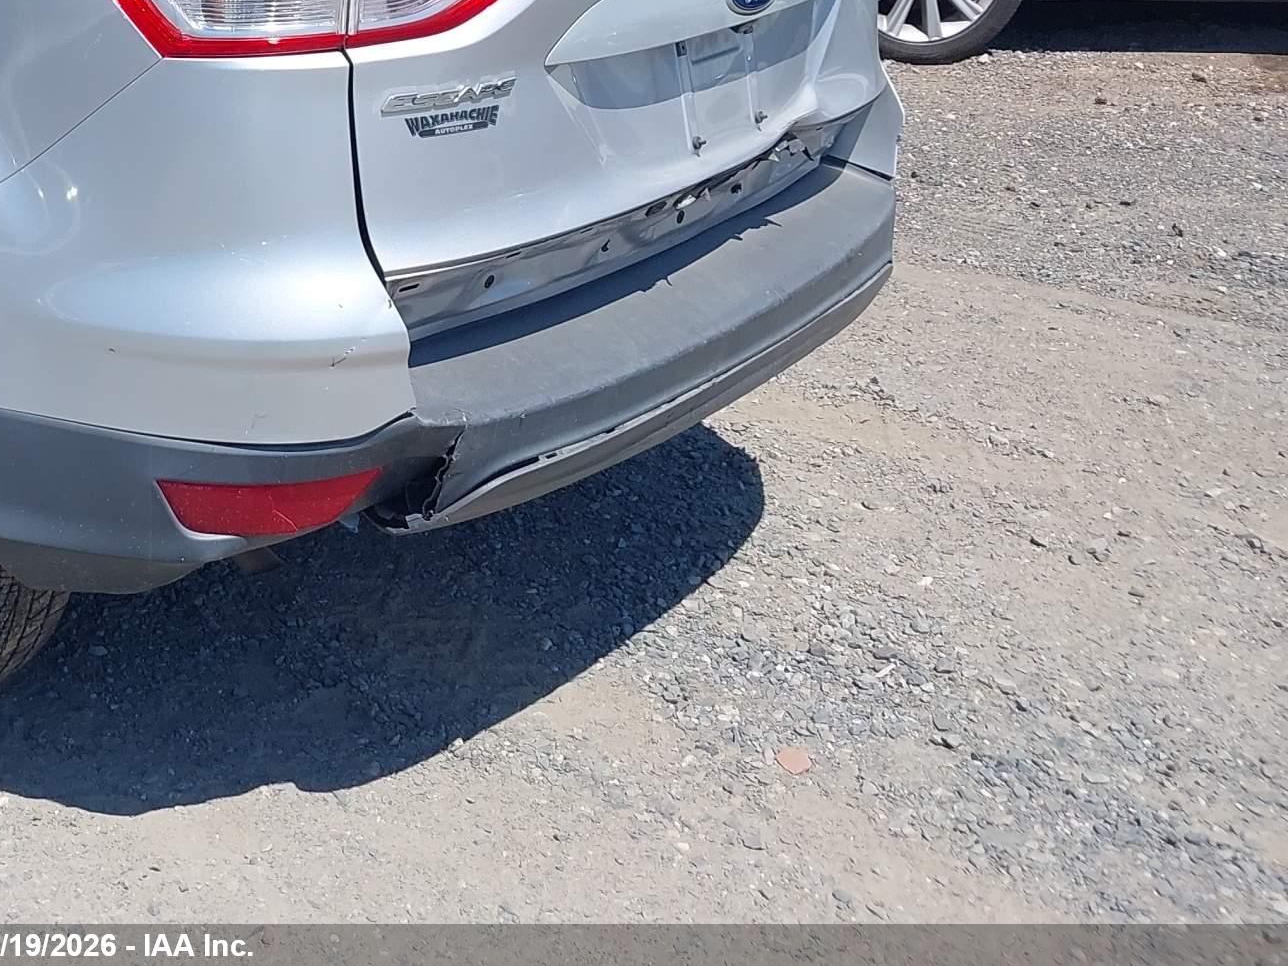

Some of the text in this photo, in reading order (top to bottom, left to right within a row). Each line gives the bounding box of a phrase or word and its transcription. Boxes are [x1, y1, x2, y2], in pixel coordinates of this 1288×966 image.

[381, 77, 516, 116] ESCAPE
[404, 104, 500, 137] WAXAHACHIE
[434, 123, 474, 135] AUTOPLEX
